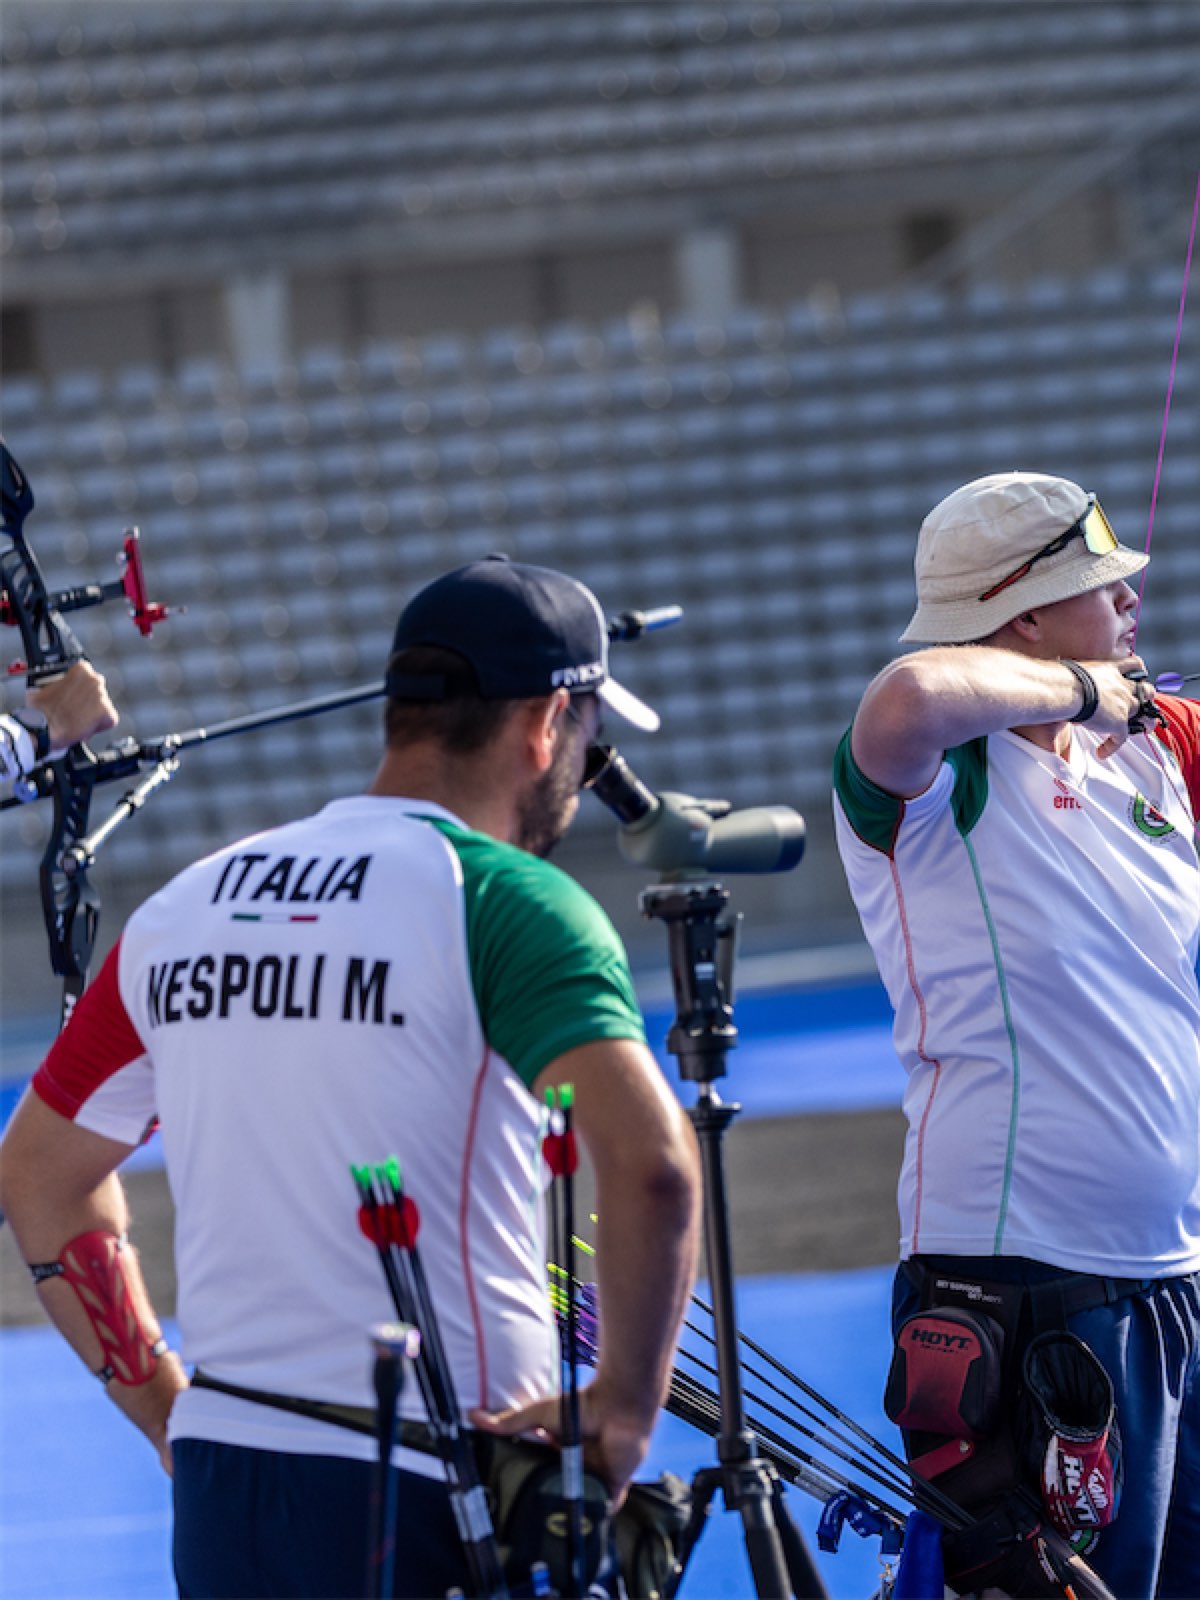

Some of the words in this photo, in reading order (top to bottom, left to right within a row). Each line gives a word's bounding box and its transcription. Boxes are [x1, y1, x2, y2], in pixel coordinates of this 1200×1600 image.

[210, 853, 373, 904] ITALIA
[148, 953, 327, 1029] NESPOLI
[341, 957, 405, 1026] M.
[911, 1328, 974, 1350] HOYT
